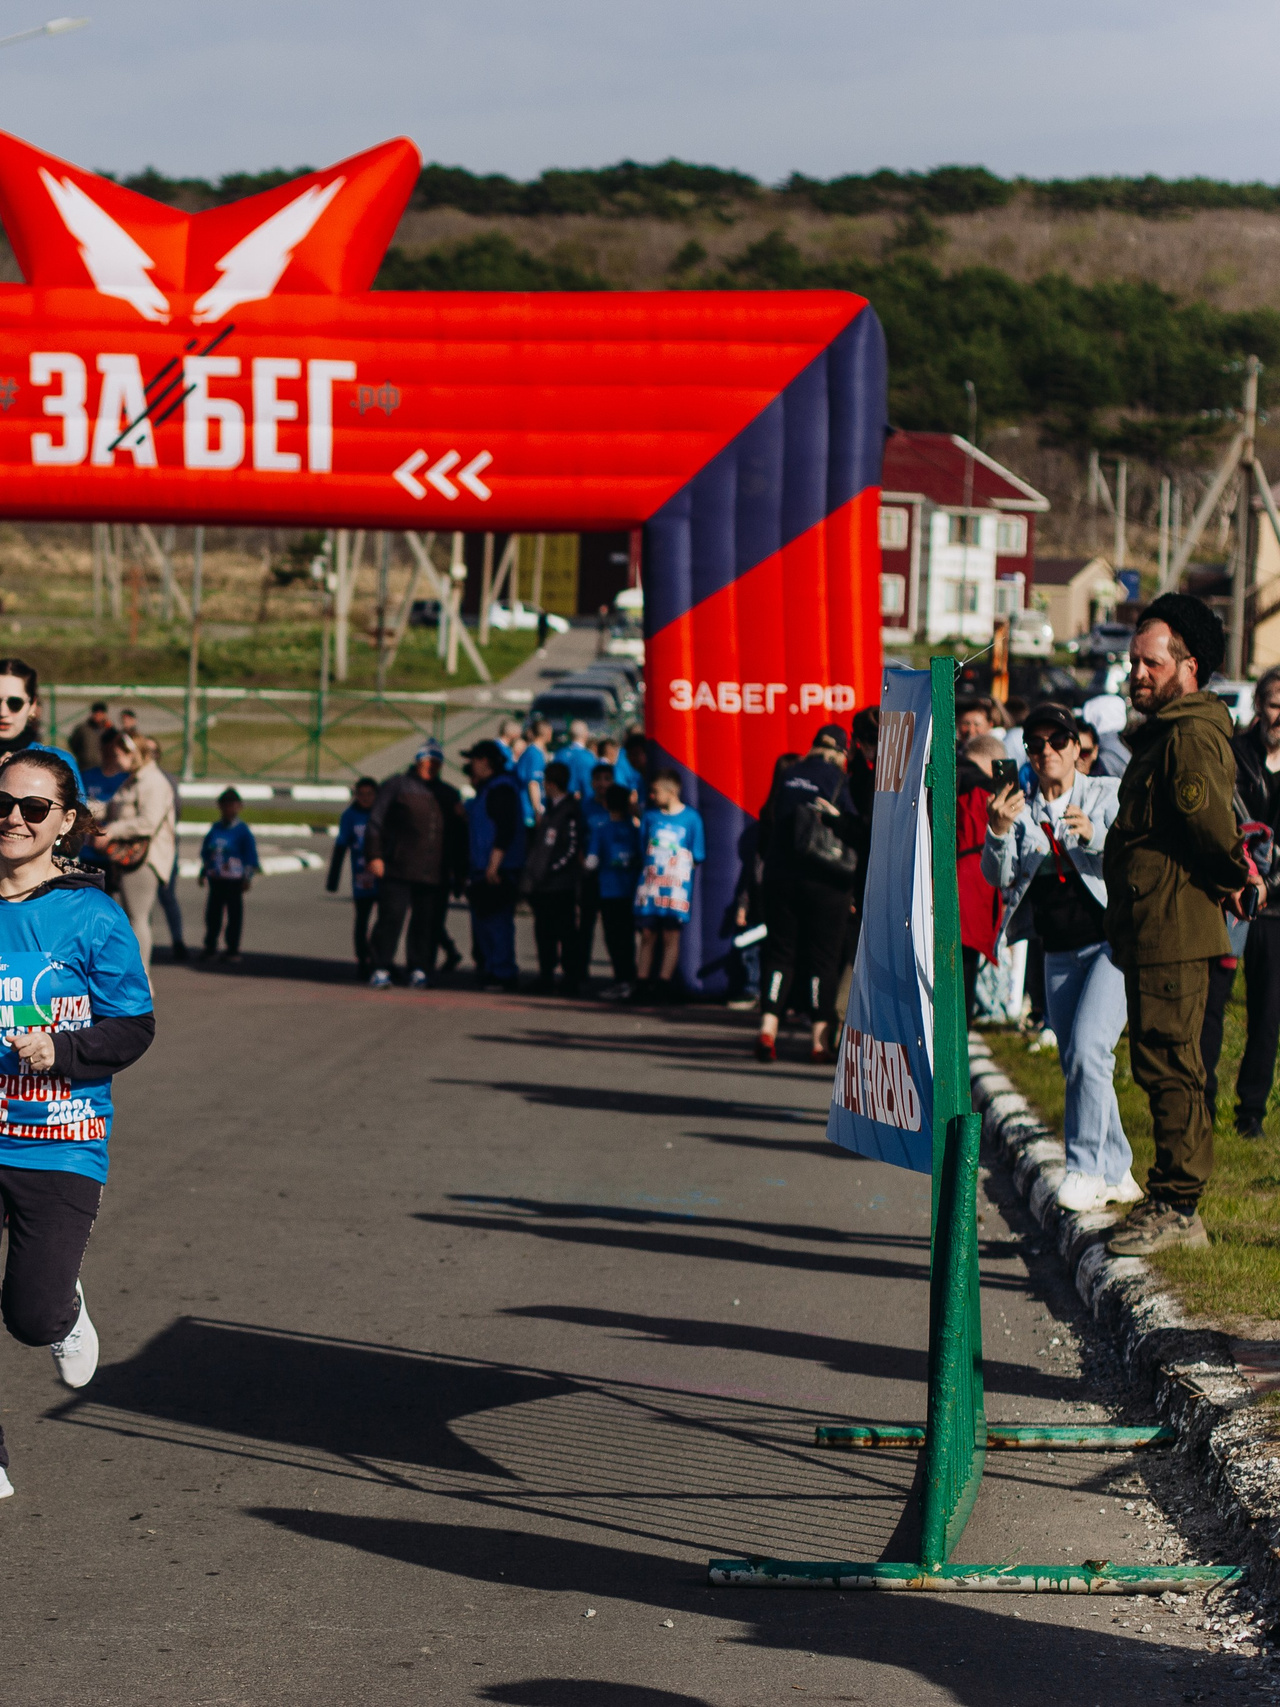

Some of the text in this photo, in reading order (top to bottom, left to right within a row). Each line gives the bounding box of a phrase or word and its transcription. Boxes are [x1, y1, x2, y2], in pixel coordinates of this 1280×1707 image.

[669, 679, 856, 713] ЗАБЕГ.РФ
[51, 995, 92, 1022] #ЦЕЛ
[46, 1098, 97, 1126] 2024
